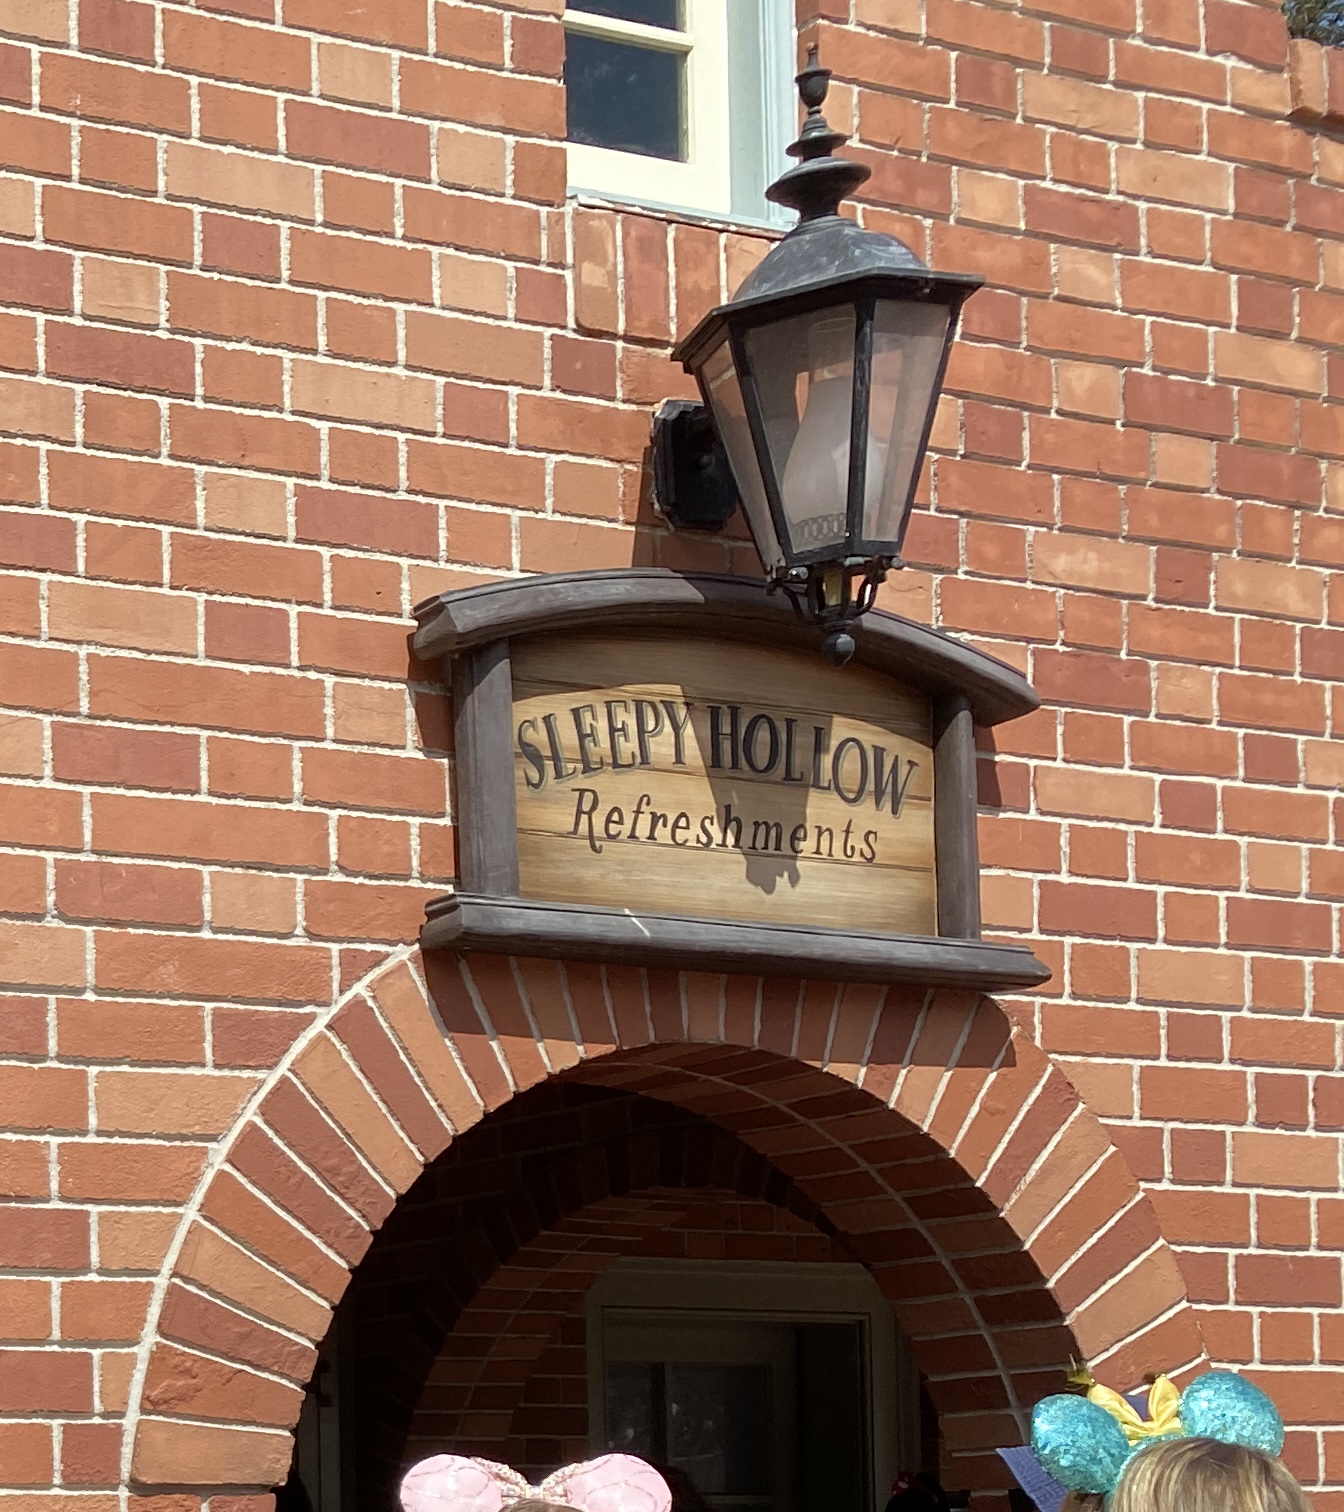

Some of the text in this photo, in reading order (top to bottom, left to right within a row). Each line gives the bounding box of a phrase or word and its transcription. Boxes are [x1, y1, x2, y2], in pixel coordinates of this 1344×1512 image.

[517, 699, 920, 817] SLEEPY HOLLOW
[571, 788, 879, 864] Refreshments
